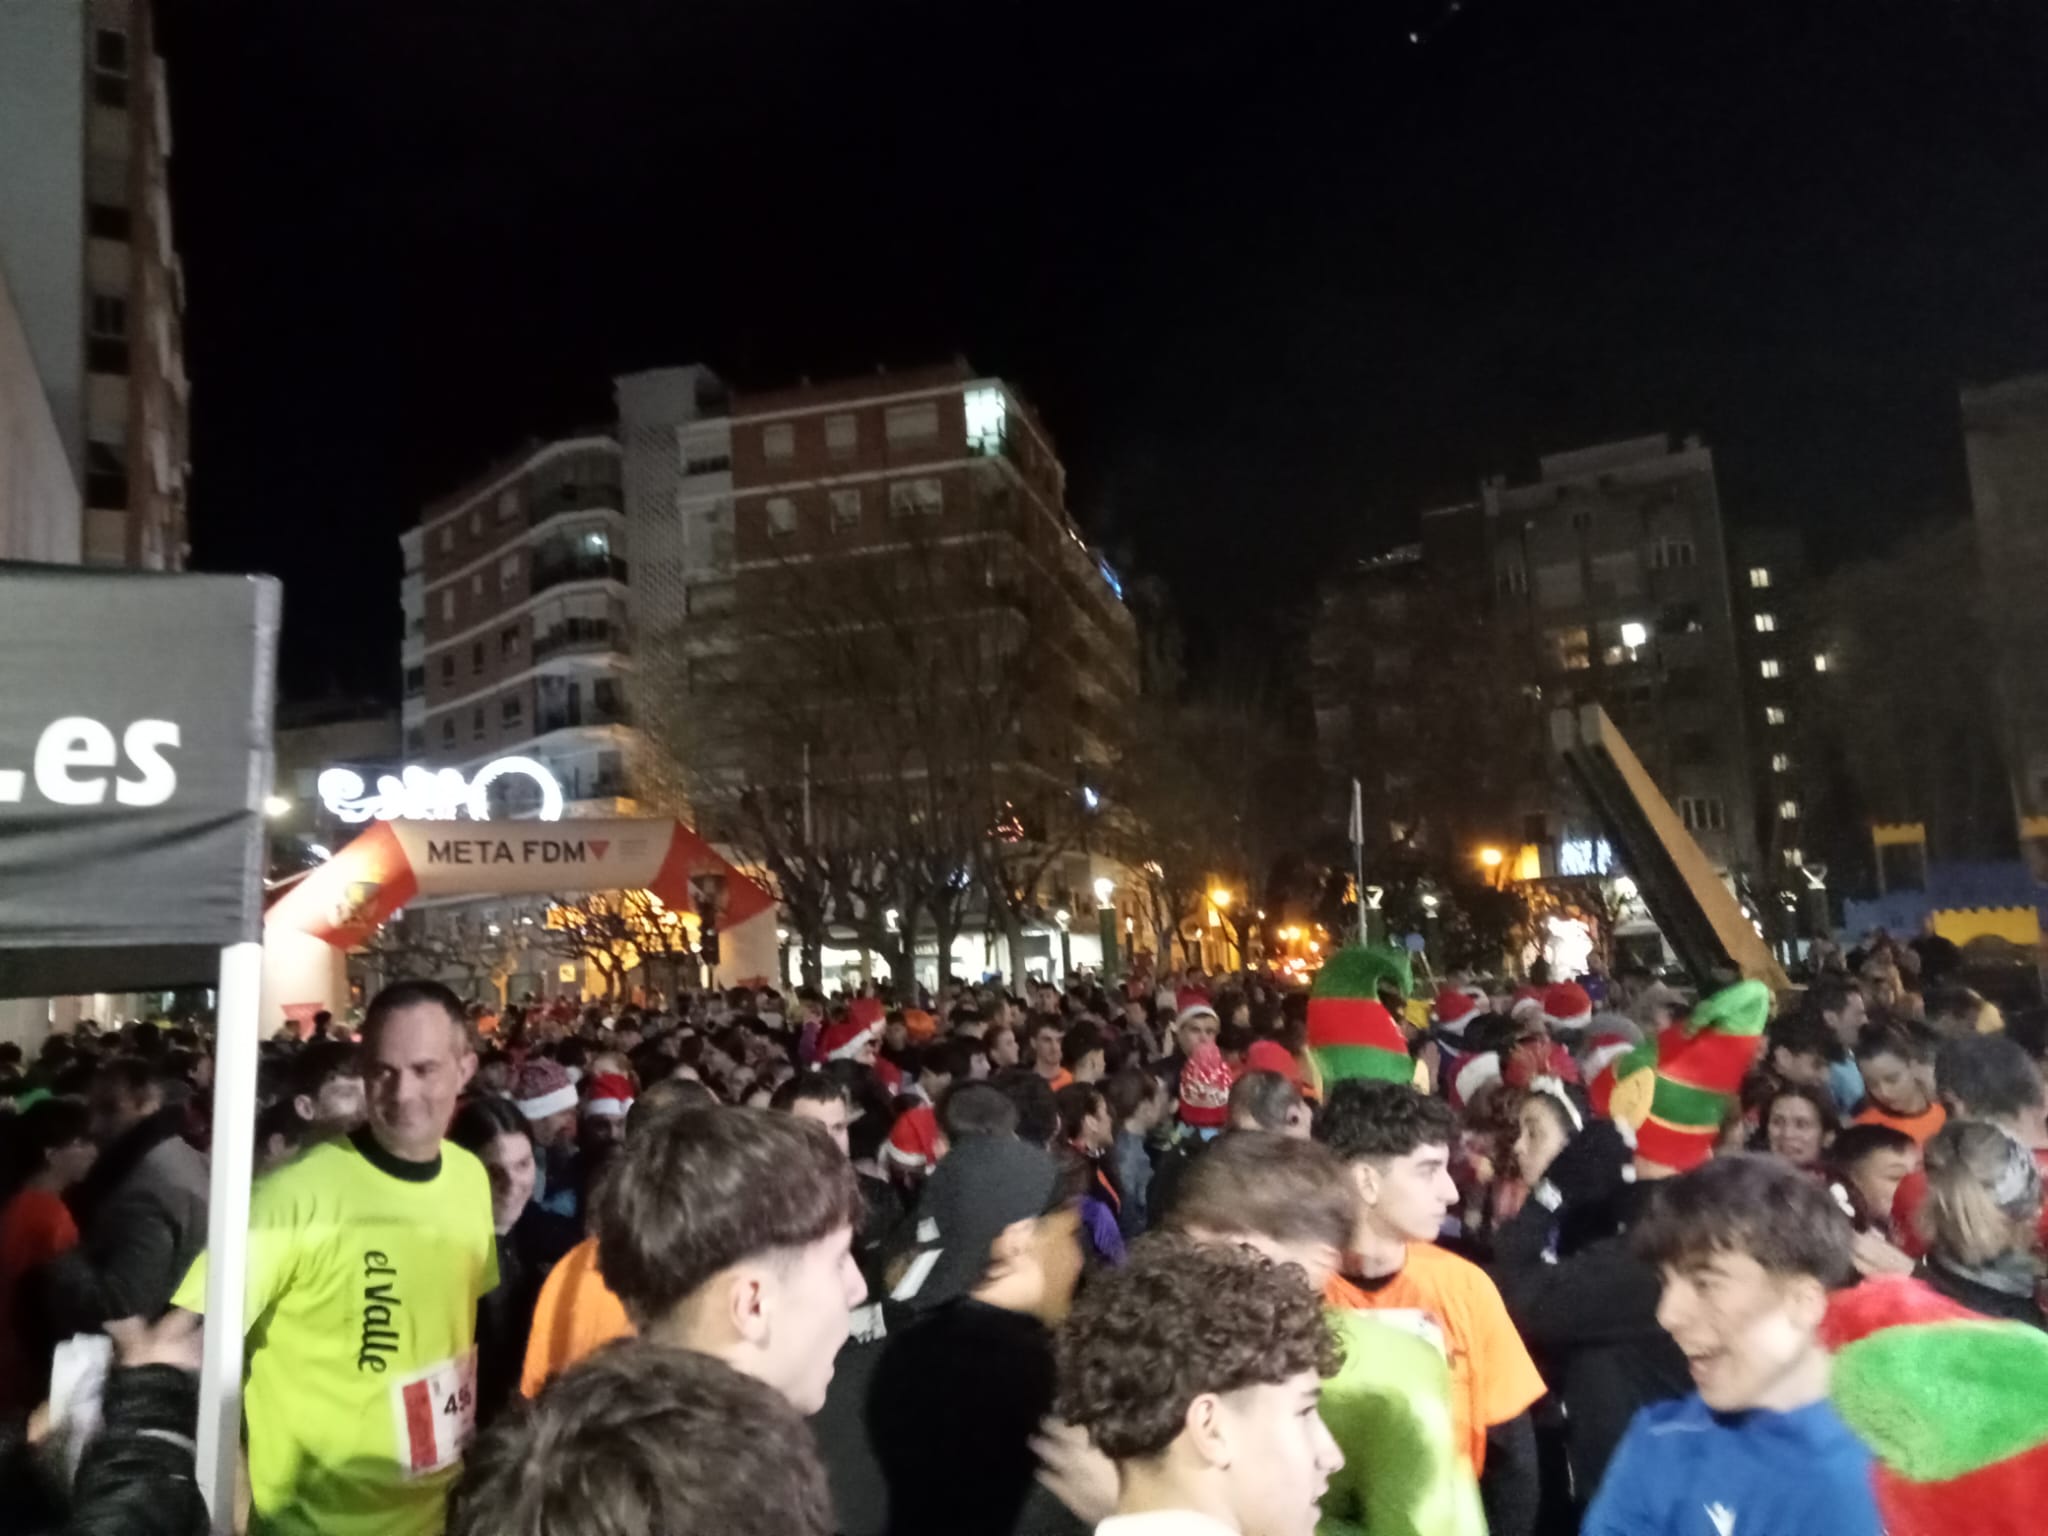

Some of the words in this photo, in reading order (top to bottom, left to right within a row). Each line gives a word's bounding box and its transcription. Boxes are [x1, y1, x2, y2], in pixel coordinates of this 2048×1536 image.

[427, 840, 514, 864] META
[523, 841, 586, 863] FDM
[364, 1250, 397, 1279] el
